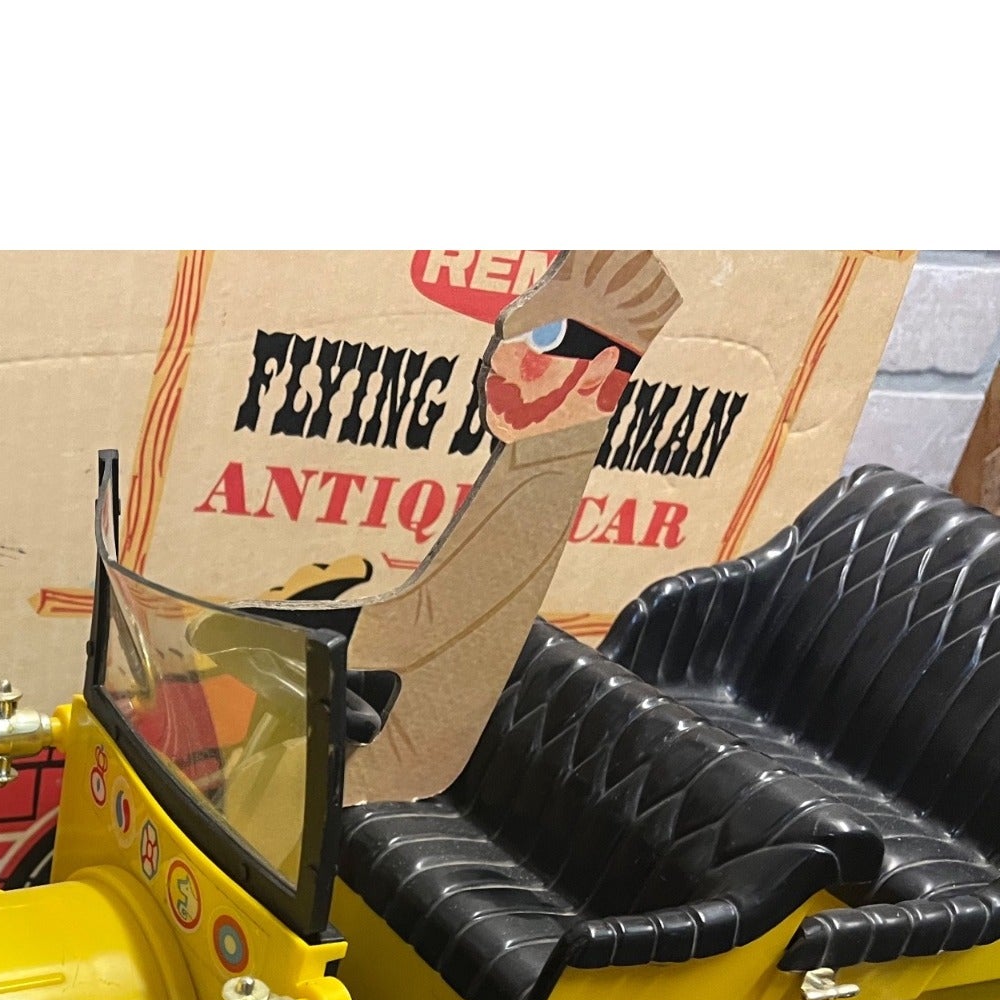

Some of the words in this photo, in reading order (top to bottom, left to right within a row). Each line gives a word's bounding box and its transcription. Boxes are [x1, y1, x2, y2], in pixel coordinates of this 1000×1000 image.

[422, 250, 547, 296] REM
[234, 329, 459, 451] FLYING
[193, 461, 473, 544] ANTIQ
[567, 494, 689, 549] CAR
